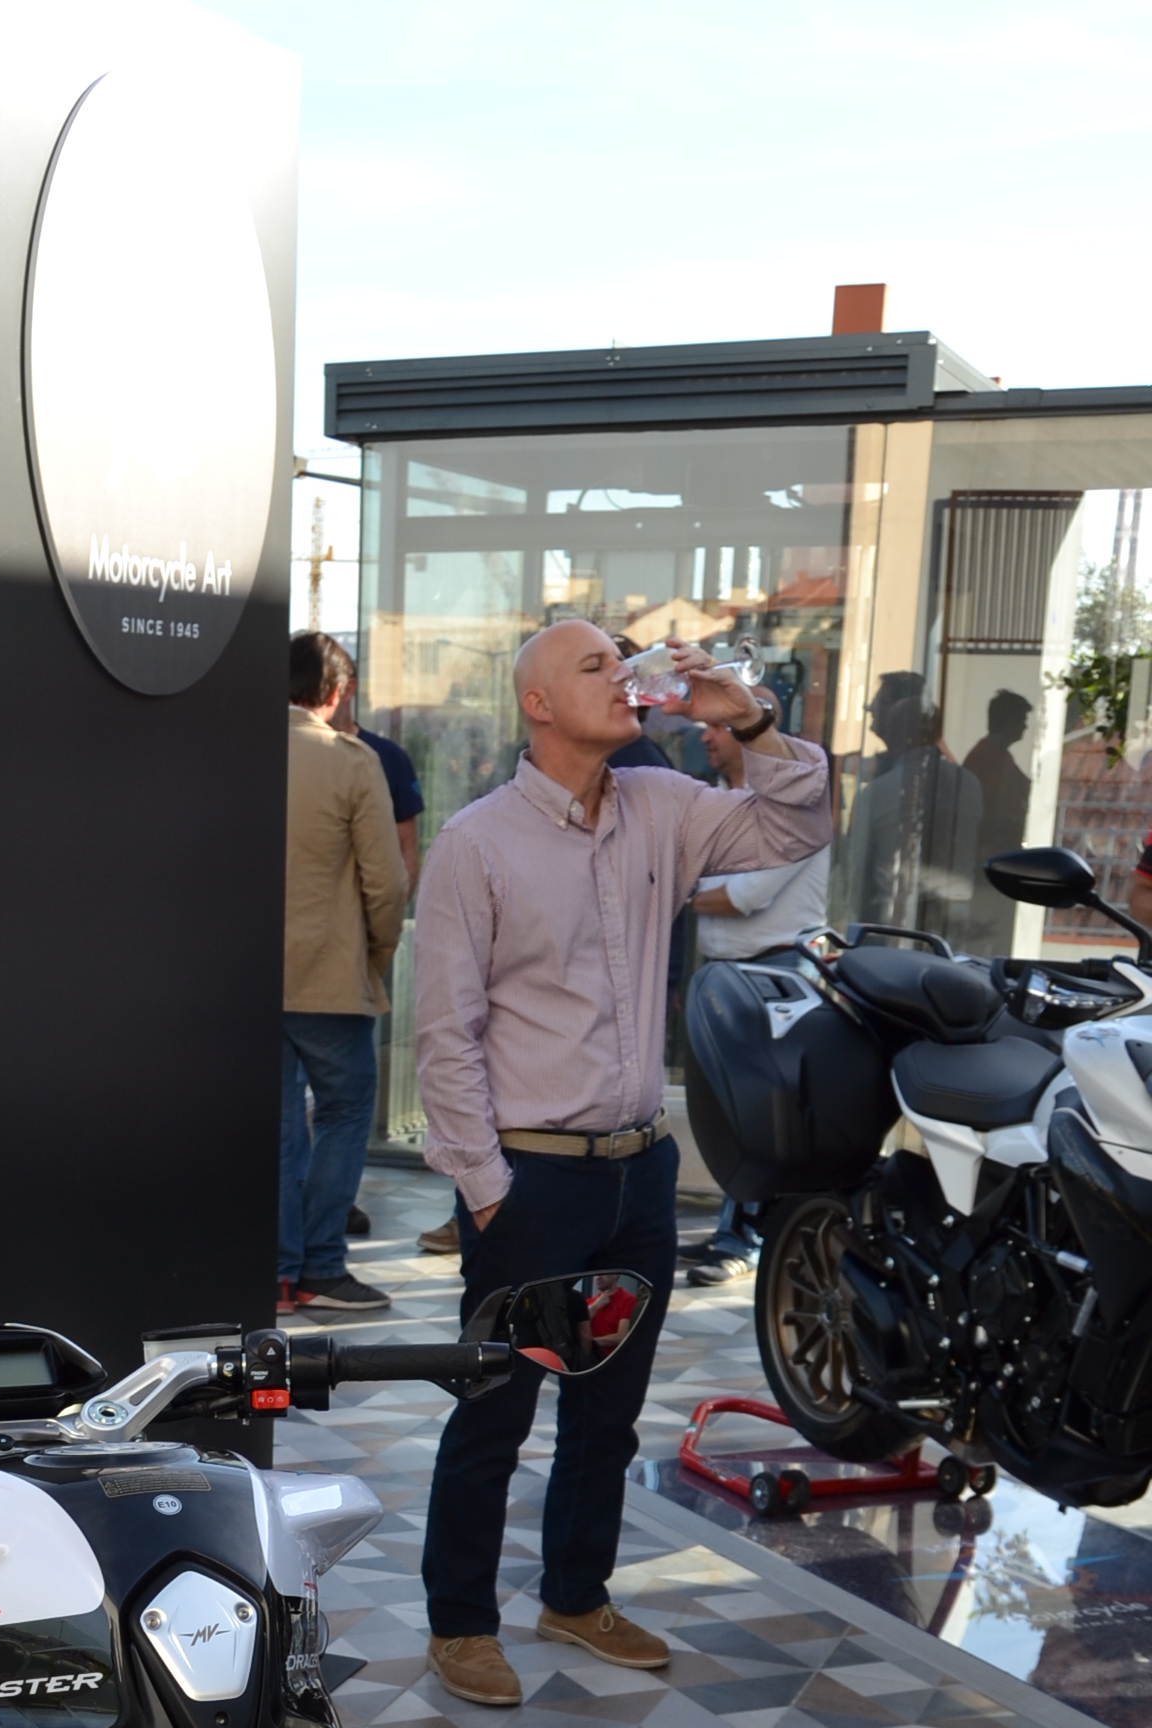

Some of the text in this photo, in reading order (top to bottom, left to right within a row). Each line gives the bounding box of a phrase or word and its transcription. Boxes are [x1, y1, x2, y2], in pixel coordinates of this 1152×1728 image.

[88, 532, 233, 603] Motorcycle Art
[121, 616, 200, 639] SINCE 1945
[157, 1500, 178, 1509] E10
[190, 1622, 221, 1647] MV
